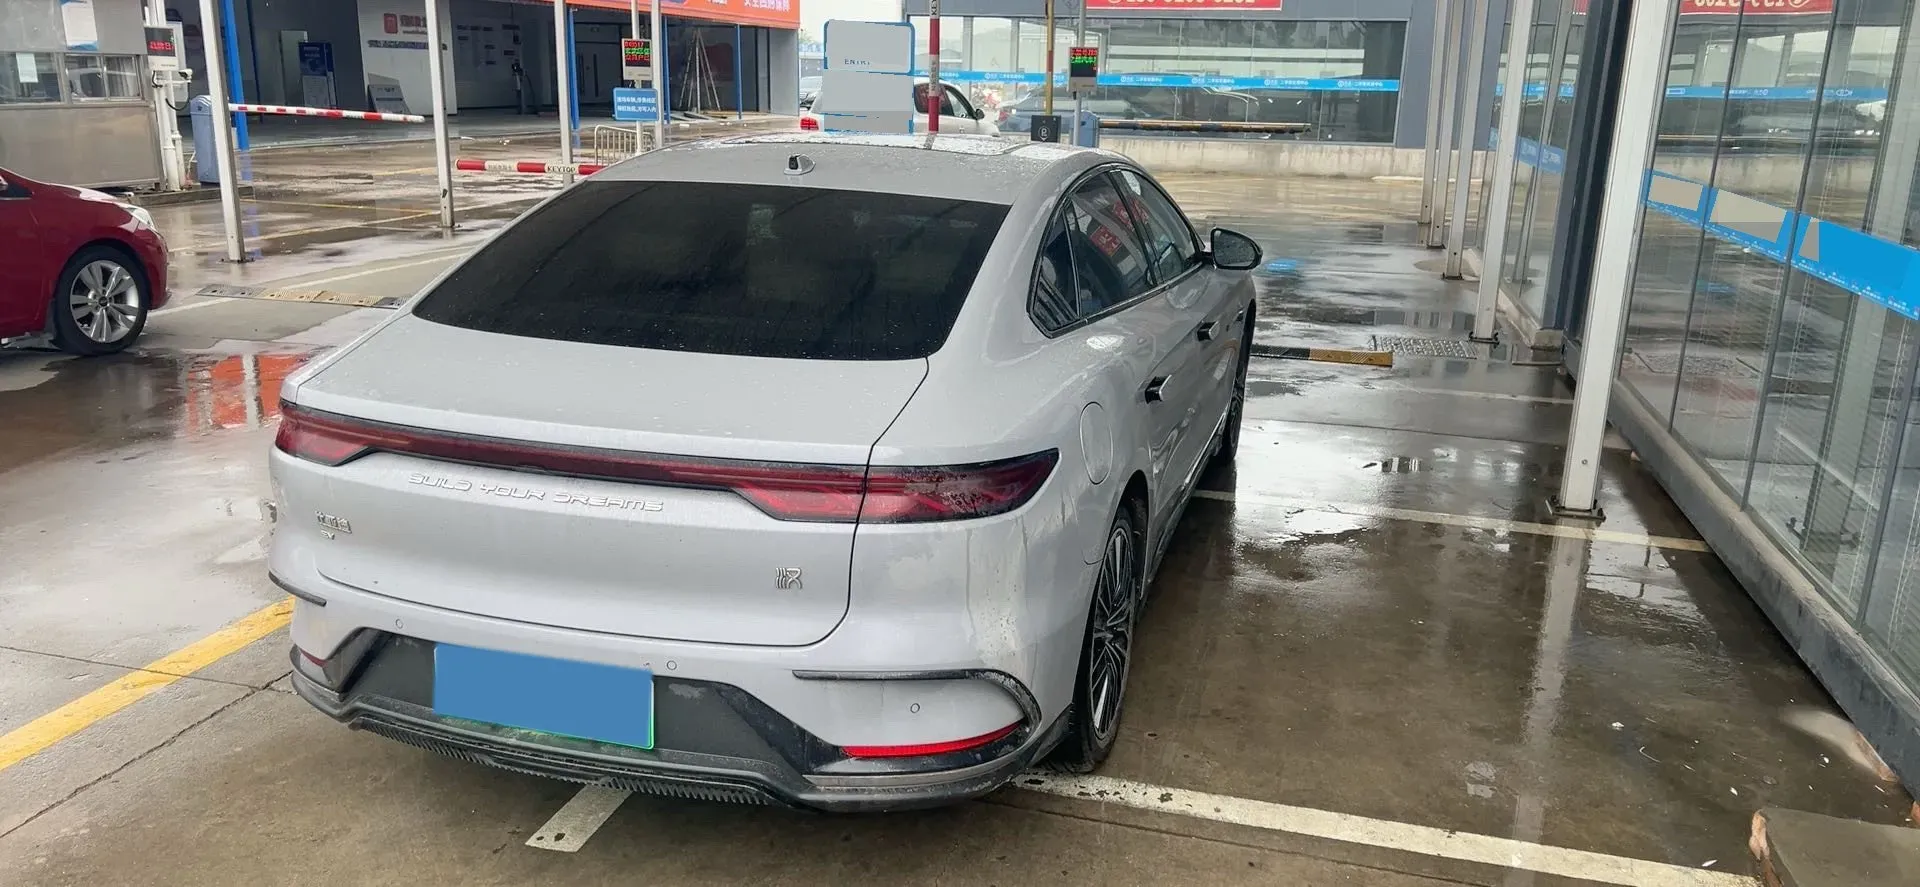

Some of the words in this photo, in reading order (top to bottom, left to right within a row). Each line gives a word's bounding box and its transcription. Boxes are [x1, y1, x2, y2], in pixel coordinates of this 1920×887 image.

[408, 472, 472, 491] BUILD
[480, 483, 546, 501] YOUR
[552, 491, 664, 512] DREAMS
